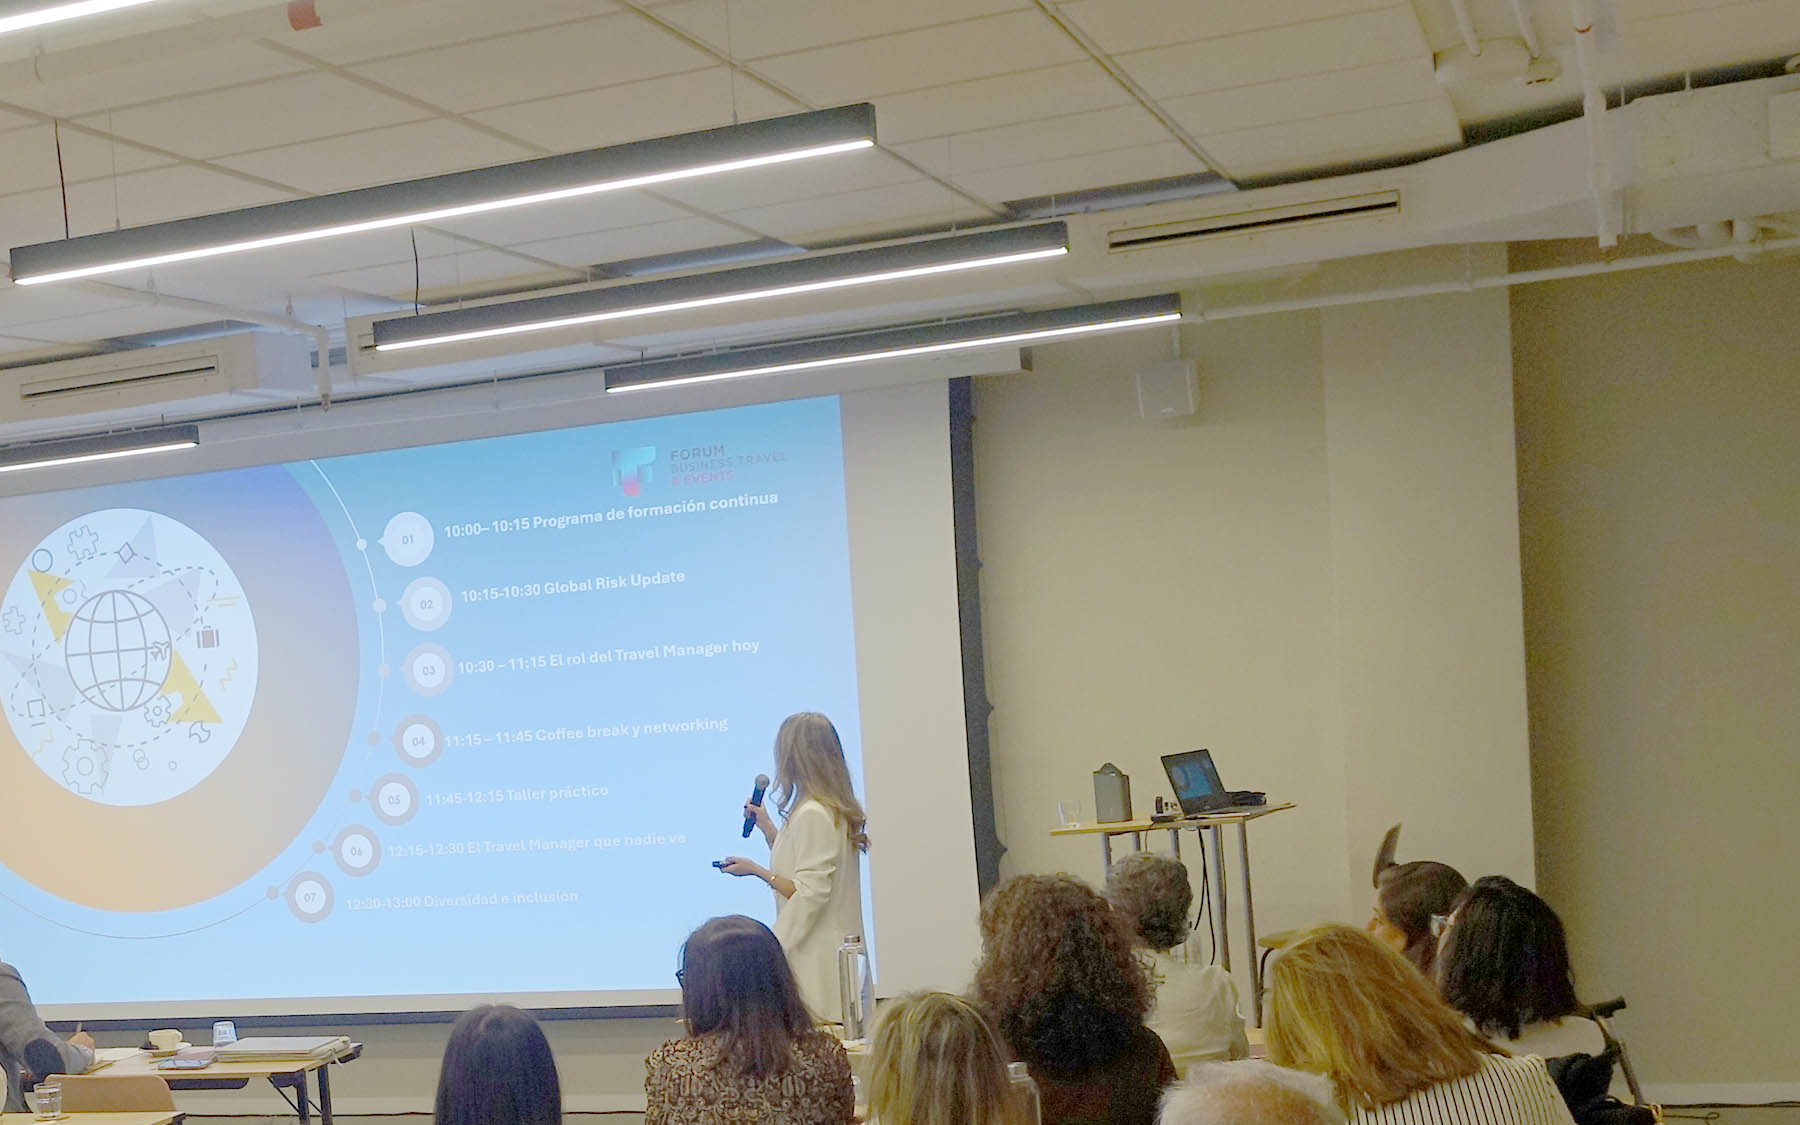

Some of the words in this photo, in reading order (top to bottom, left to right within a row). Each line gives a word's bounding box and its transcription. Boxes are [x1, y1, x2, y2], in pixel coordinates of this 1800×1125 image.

[670, 444, 725, 461] FORUM
[492, 517, 530, 533] 10:15
[533, 511, 603, 529] Programa
[606, 508, 625, 521] de
[627, 500, 706, 519] formación
[709, 493, 779, 510] continua
[402, 534, 414, 545] 01
[544, 579, 593, 595] Global
[596, 574, 627, 590] Risk
[631, 571, 686, 588] Update
[419, 599, 433, 610] 02
[457, 659, 495, 674] 10:30
[508, 655, 546, 671] 11:15
[550, 654, 564, 667] El
[566, 651, 586, 665] rol
[589, 650, 613, 664] del
[614, 645, 660, 662] Travel
[663, 642, 729, 658] Manager
[732, 639, 761, 655] hoy
[422, 665, 436, 676] 03
[445, 733, 481, 747] 11:15
[496, 729, 533, 745] 11:45
[535, 727, 584, 741] Coffee
[587, 722, 629, 738] break
[631, 724, 641, 738] y
[643, 717, 729, 734] networking
[411, 736, 425, 747] 04
[388, 795, 401, 806] 05
[506, 786, 546, 801] Taller
[549, 784, 609, 803] práctico
[484, 839, 527, 854] Travel
[528, 838, 589, 853] Manager
[592, 837, 621, 851] que
[624, 832, 665, 846] nadie
[304, 893, 317, 903] 07
